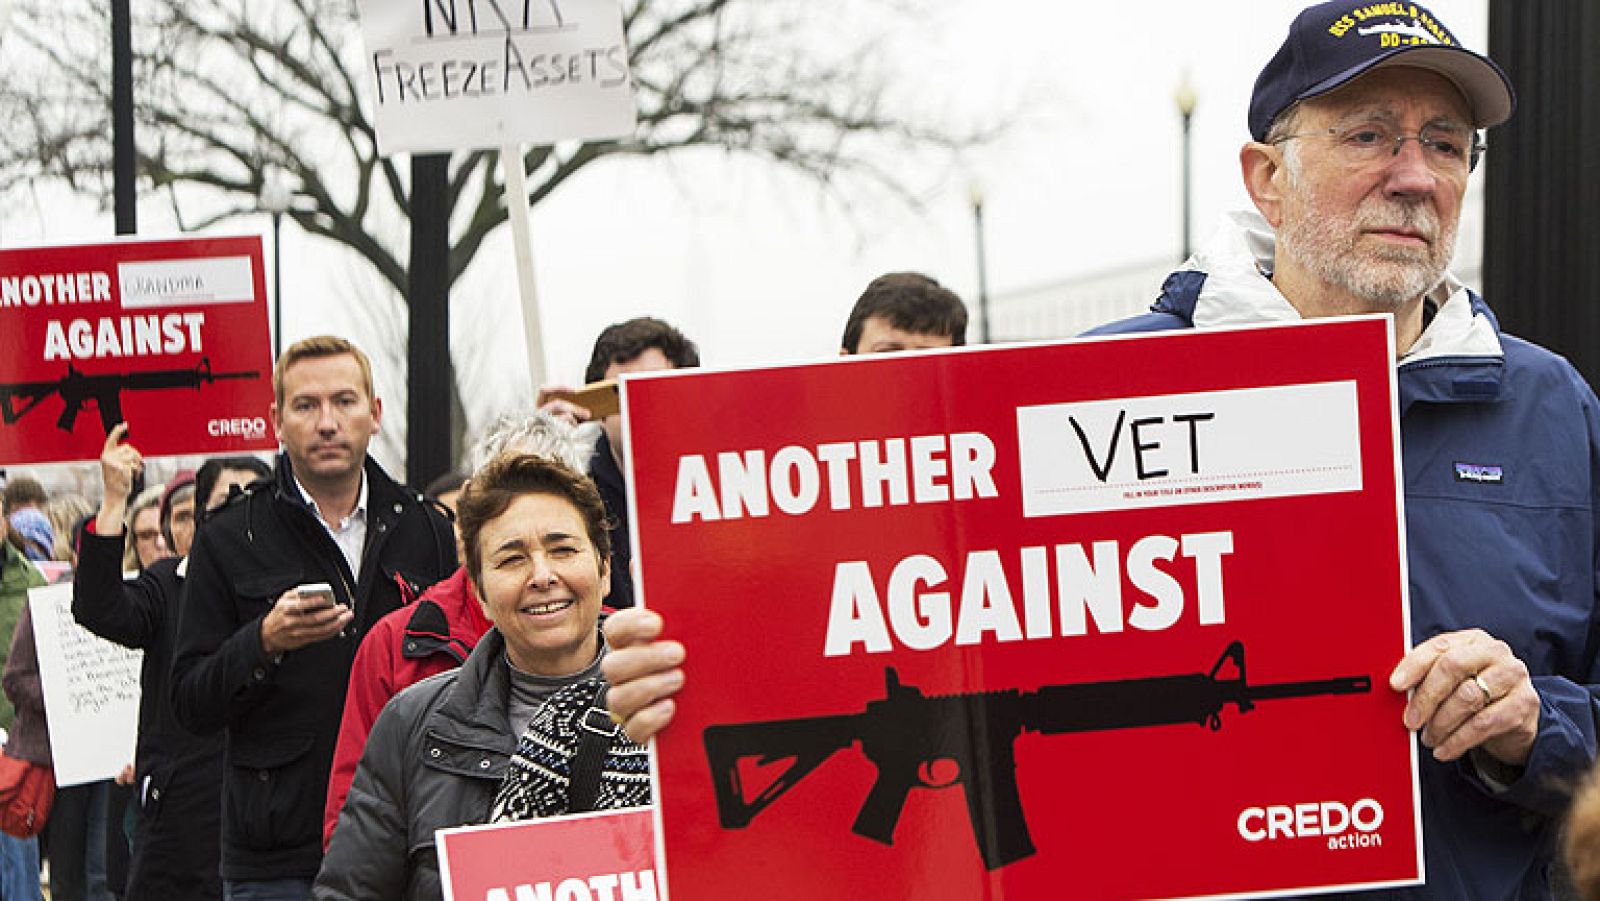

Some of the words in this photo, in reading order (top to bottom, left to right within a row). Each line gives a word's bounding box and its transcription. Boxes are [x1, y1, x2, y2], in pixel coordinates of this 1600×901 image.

[373, 49, 498, 104] FREEZE
[502, 34, 627, 93] ASSETS
[0, 271, 111, 307] NOTHER
[44, 312, 205, 361] AGAINST
[207, 417, 266, 437] CREDO
[671, 431, 999, 524] ANOTHER
[1069, 409, 1215, 483] VET
[824, 531, 1234, 657] AGAINST
[1237, 797, 1384, 842] CREDO
[1328, 831, 1382, 850] action
[485, 869, 656, 901] OTH
